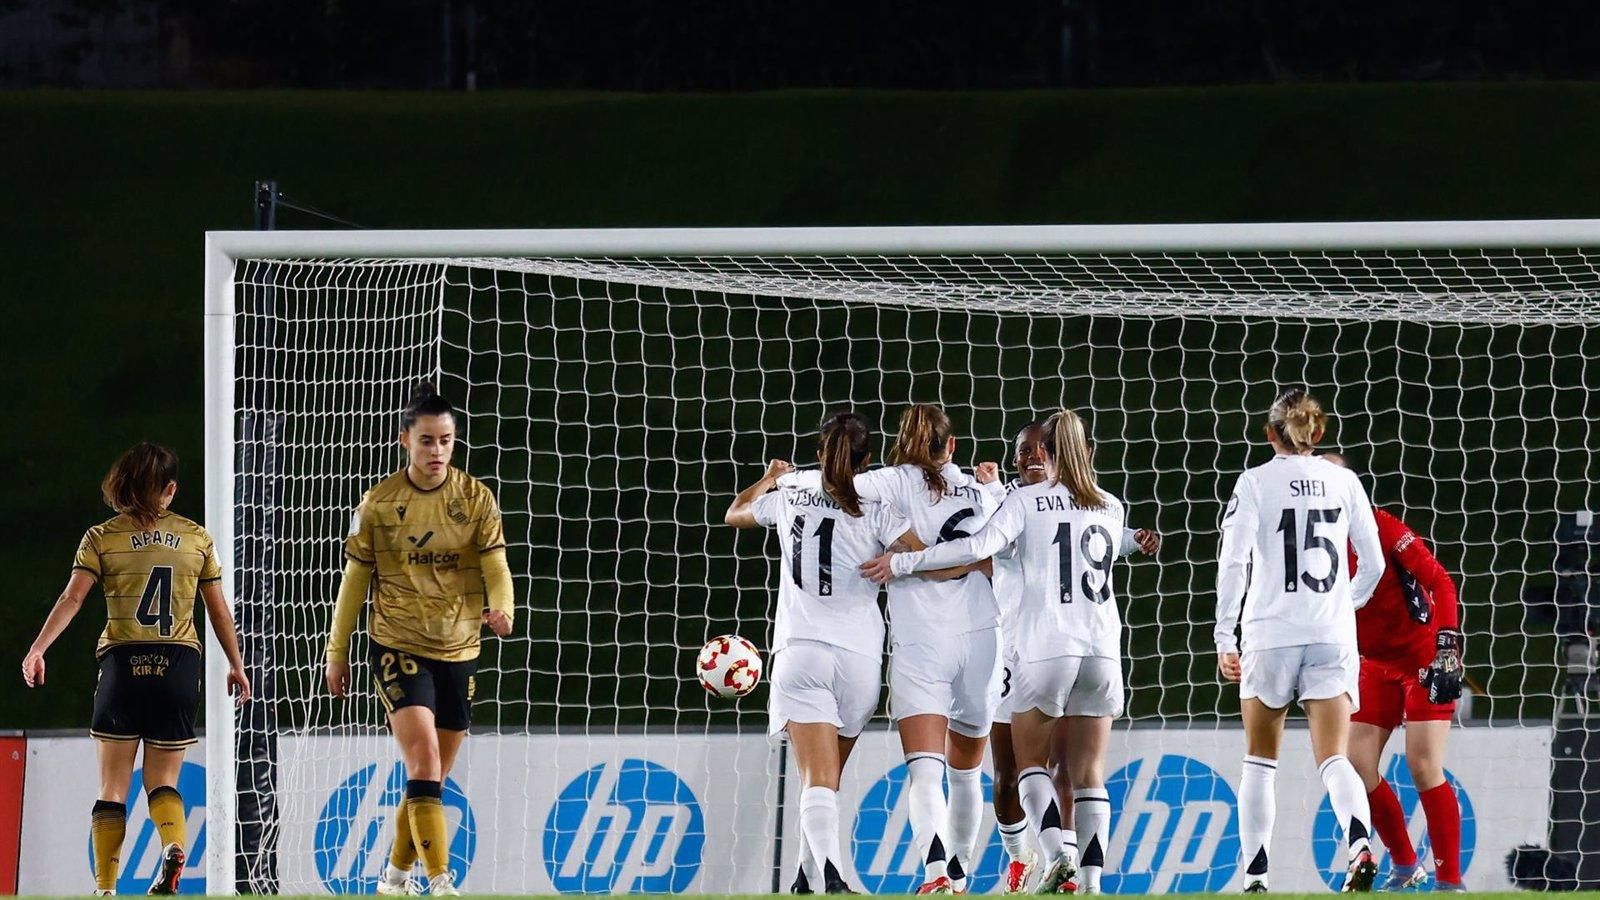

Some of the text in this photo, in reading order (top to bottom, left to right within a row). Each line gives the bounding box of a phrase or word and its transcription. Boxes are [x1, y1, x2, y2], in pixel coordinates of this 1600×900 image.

[1036, 495, 1065, 512] EVA
[1289, 480, 1326, 498] SHEI
[130, 530, 181, 550] APARI
[408, 550, 460, 566] Halcón
[789, 514, 836, 597] 11
[1051, 522, 1114, 605] 19
[1276, 507, 1342, 594] 15
[135, 566, 174, 638] 4
[380, 652, 418, 682] 26
[558, 757, 692, 895] hp
[1101, 755, 1232, 894] hp
